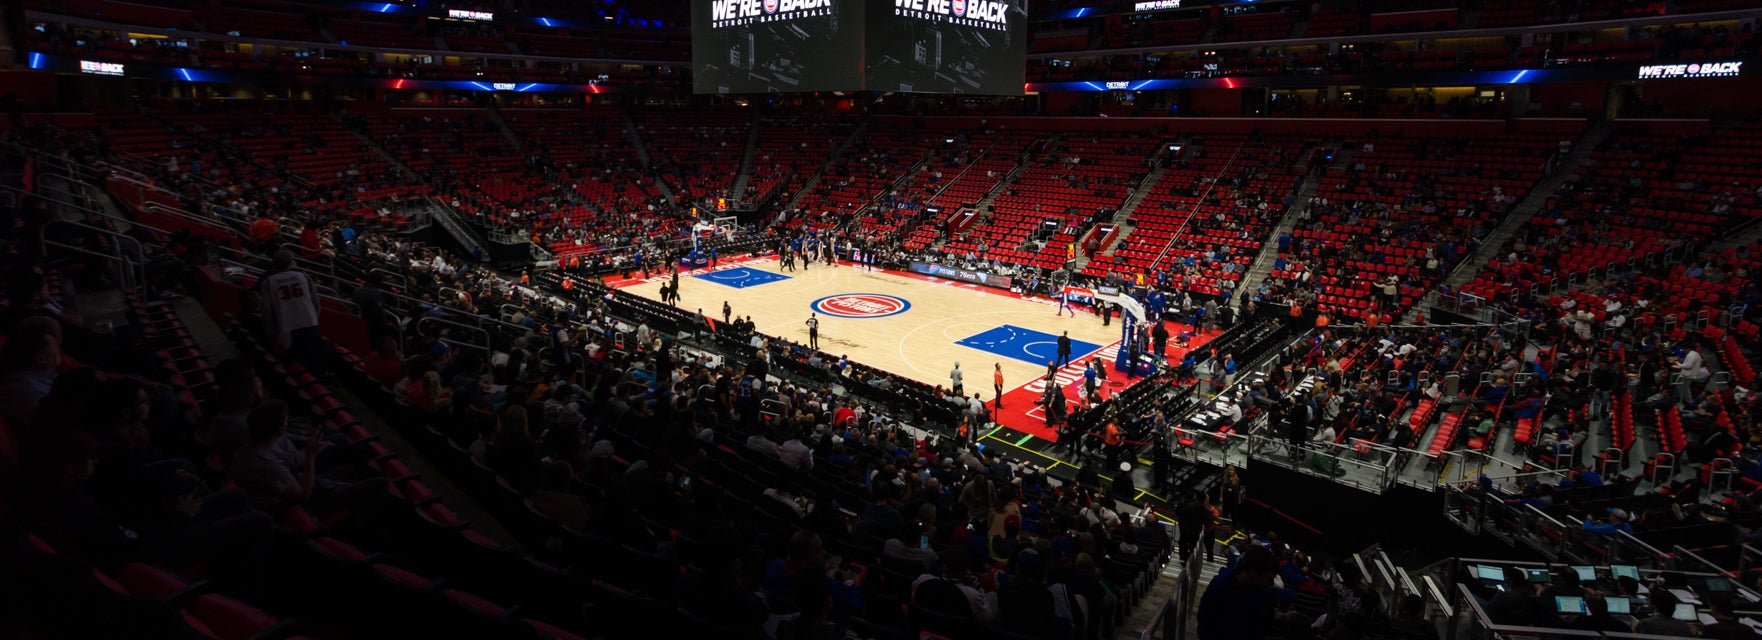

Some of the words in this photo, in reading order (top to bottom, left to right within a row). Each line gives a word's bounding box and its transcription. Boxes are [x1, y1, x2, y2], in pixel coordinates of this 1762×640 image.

[712, 0, 761, 20] WE'RE
[713, 18, 753, 28] DETROIT
[761, 8, 831, 22] BASKETBALL
[895, 9, 941, 21] DETROIT
[949, 17, 1007, 31] BASKETBALL
[967, 0, 1008, 24] BACK
[1640, 65, 1687, 75] WE'RE
[1700, 62, 1742, 74] BACK
[960, 271, 976, 280] 76ers
